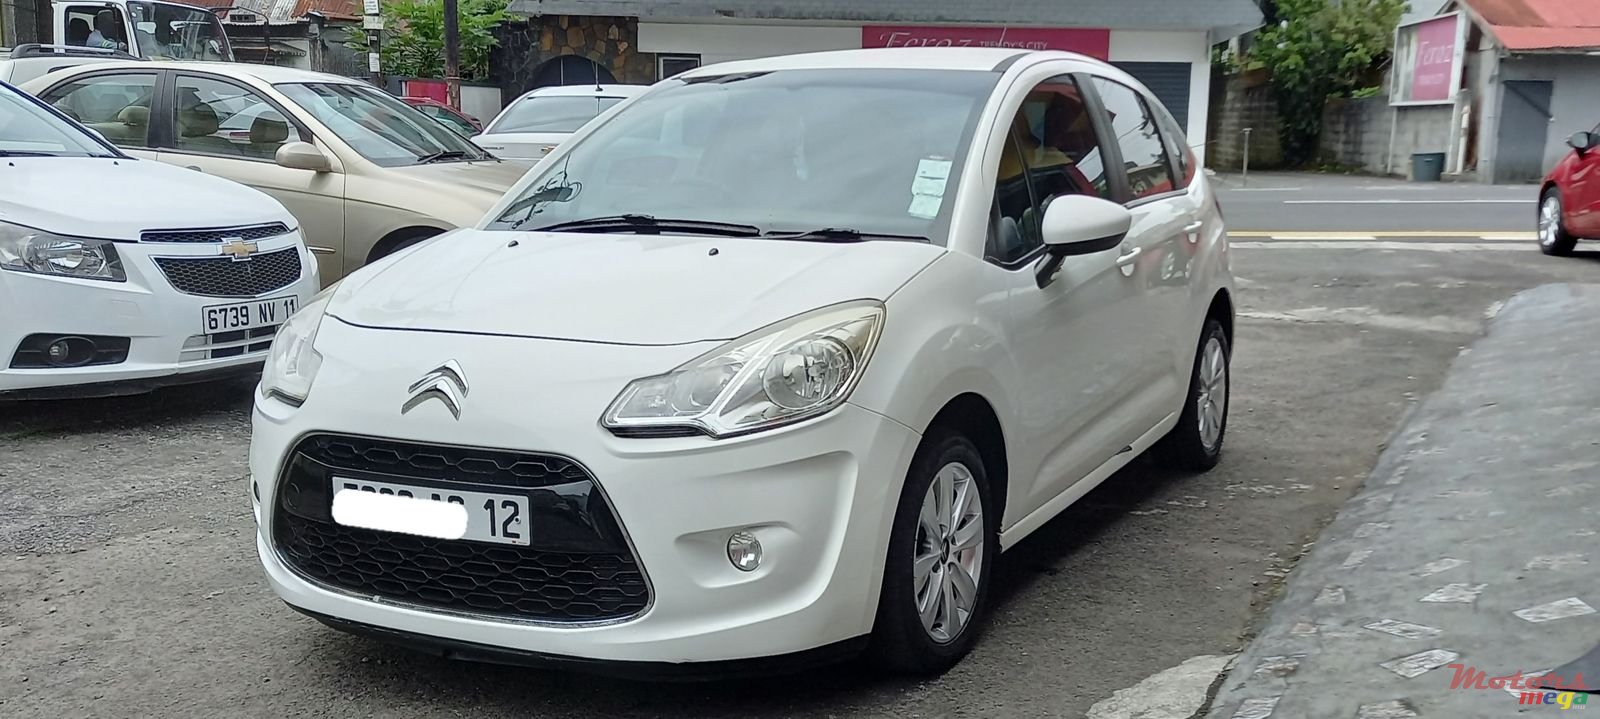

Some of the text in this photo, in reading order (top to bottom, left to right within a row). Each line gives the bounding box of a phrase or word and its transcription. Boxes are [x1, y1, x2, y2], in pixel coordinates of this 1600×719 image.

[1026, 41, 1048, 49] CITY
[208, 299, 295, 330] 6739 NV 11
[483, 499, 521, 539] 12
